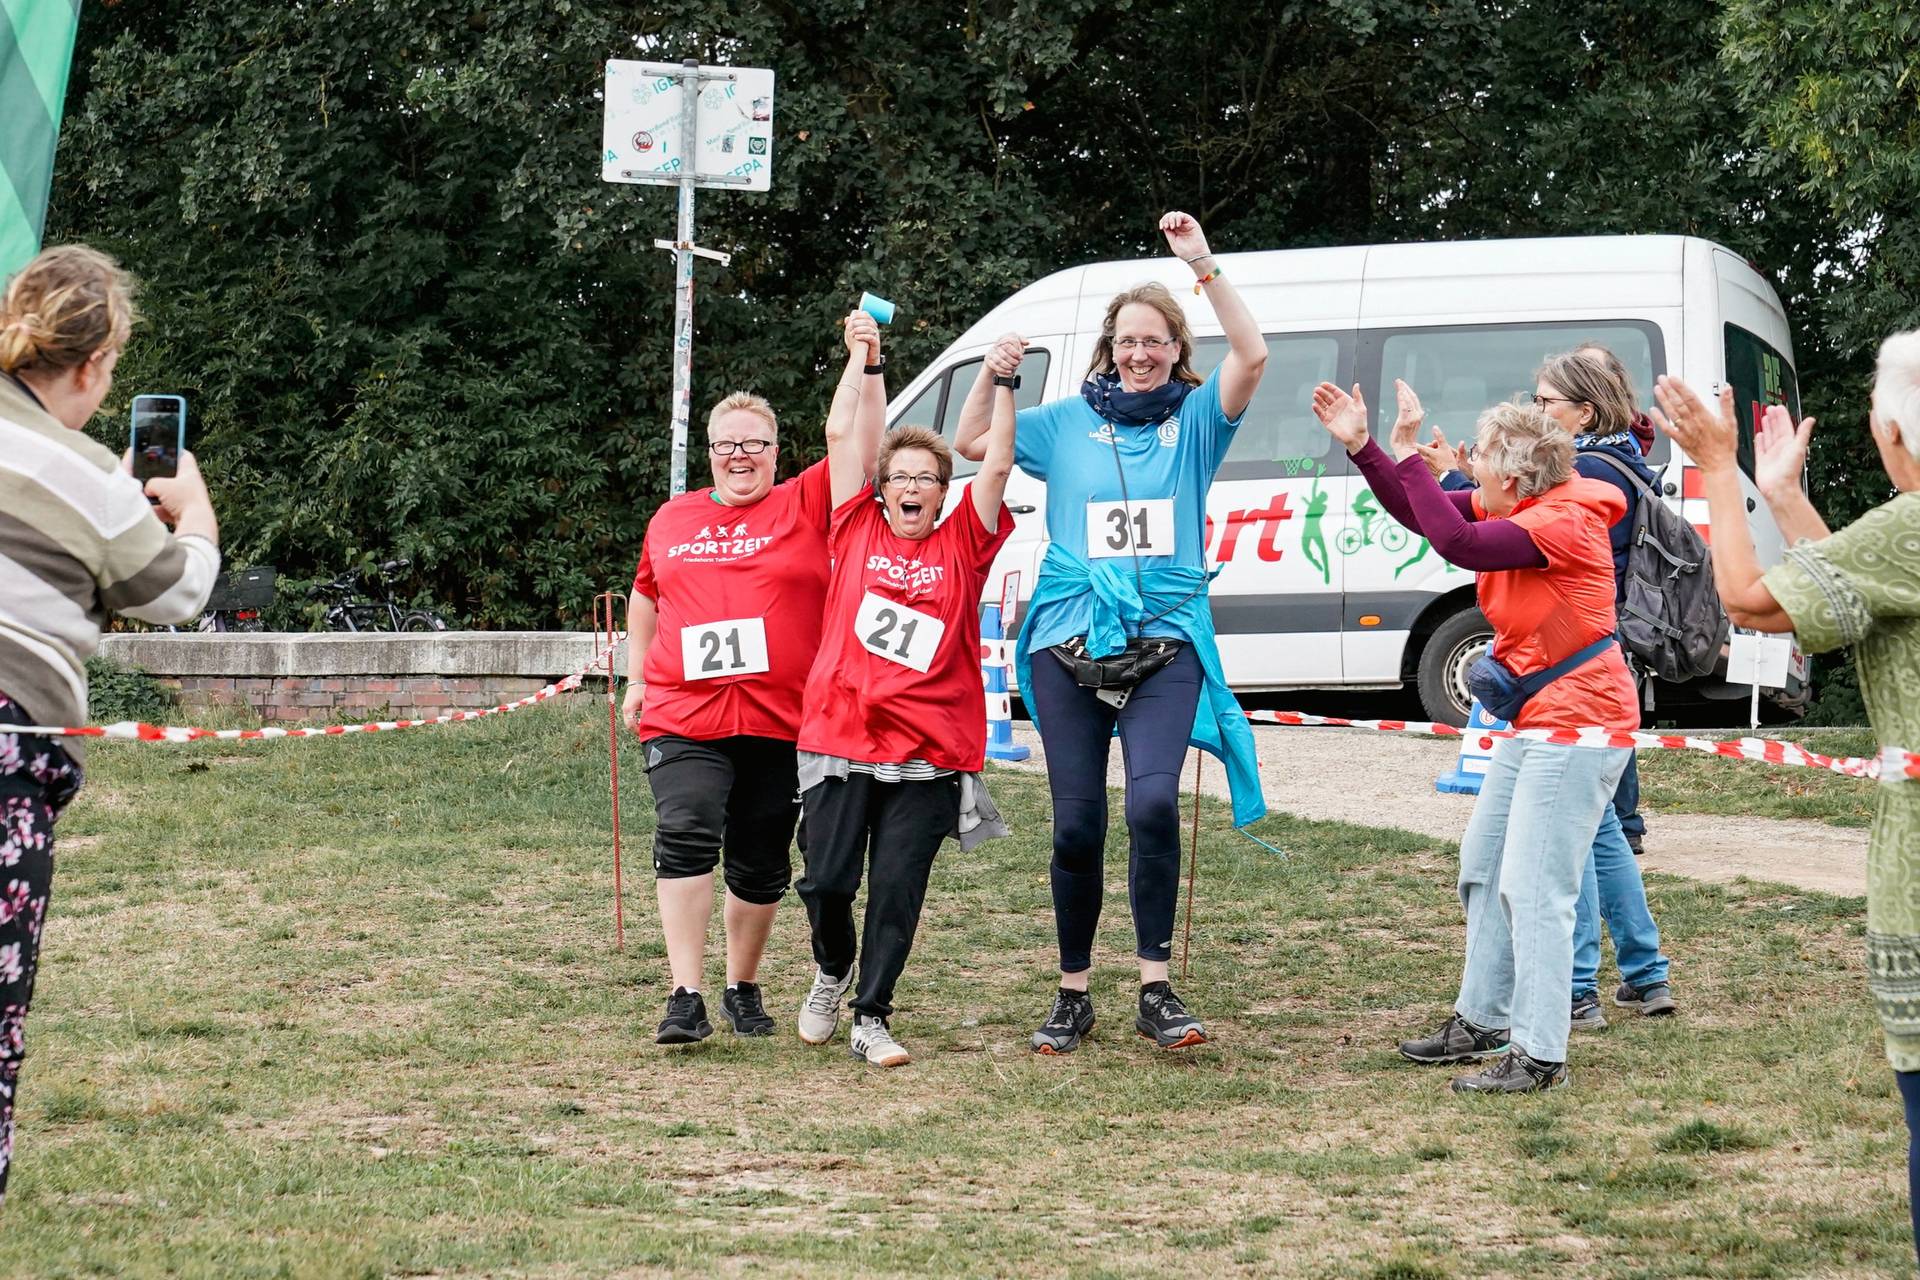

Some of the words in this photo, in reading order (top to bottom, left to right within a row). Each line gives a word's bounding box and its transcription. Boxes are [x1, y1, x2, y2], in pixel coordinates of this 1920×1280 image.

[667, 536, 773, 558] SPORTZEIT
[1106, 508, 1152, 551] 31
[699, 627, 746, 672] 21
[866, 608, 919, 659] 21
